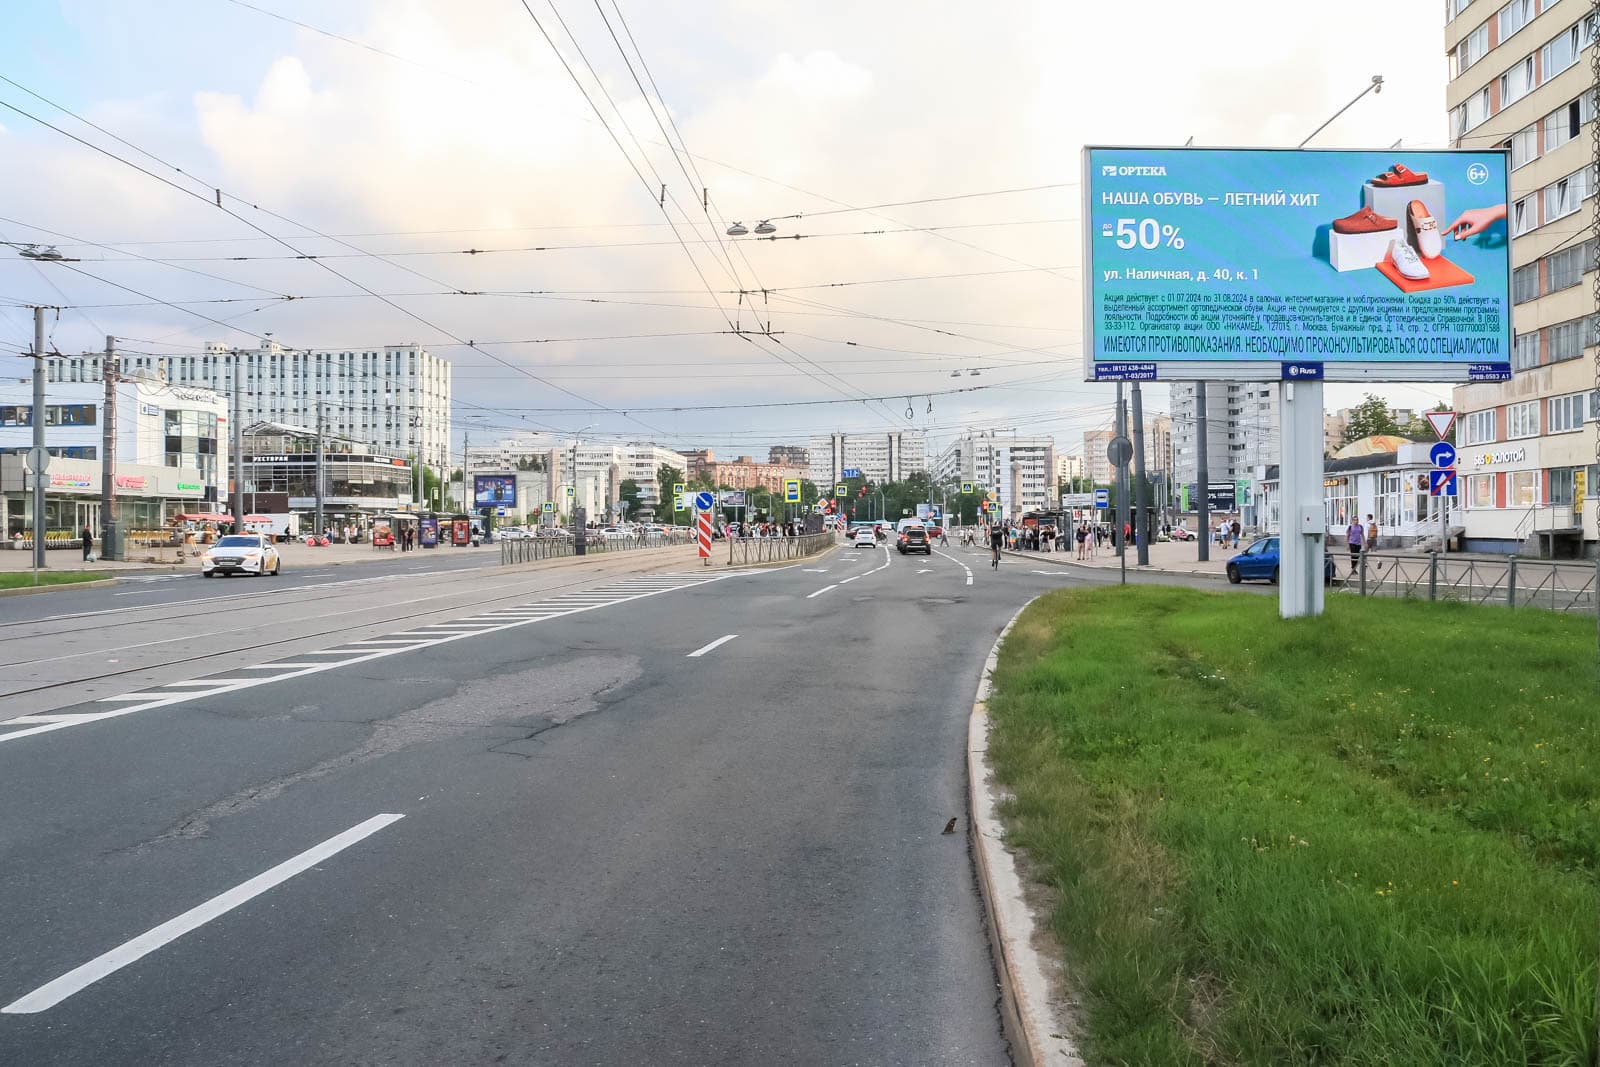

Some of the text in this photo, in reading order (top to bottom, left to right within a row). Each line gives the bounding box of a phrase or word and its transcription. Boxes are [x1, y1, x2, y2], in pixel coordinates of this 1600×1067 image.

[1119, 166, 1167, 176] ОРТЕКА
[1469, 167, 1486, 180] 6+
[1102, 191, 1149, 205] НАША
[1153, 192, 1204, 206] ОБУВЬ
[1223, 190, 1286, 207] ЛЕТНИЙ
[1289, 193, 1320, 207] ХИТ
[1103, 268, 1259, 282] ул. Наличная, д. 40, к. 1
[1104, 293, 1124, 304] Акция
[1126, 293, 1159, 304] действует
[1203, 295, 1212, 303] по
[1408, 295, 1431, 305] Скидка
[1433, 297, 1442, 305] до
[1443, 296, 1457, 304] 50%
[1458, 296, 1490, 305] действует
[1147, 304, 1189, 312] ассортимент
[1267, 304, 1287, 313] Акция
[1347, 306, 1375, 314] другими
[1376, 306, 1404, 314] акциями
[1145, 313, 1189, 323] Подробности
[1190, 313, 1199, 322] об
[1200, 314, 1220, 323] акции
[1139, 322, 1181, 332] Организатор
[1183, 323, 1203, 332] акции
[1103, 335, 1499, 356] ИМЕЮТСЯ ПРОТИВОПОКАЗАНИЯ. НЕОБХОДИМО ПРОКОНСУЛЬТИРОВАТЬСЯ СО СПЕЦИАЛИСТОМ
